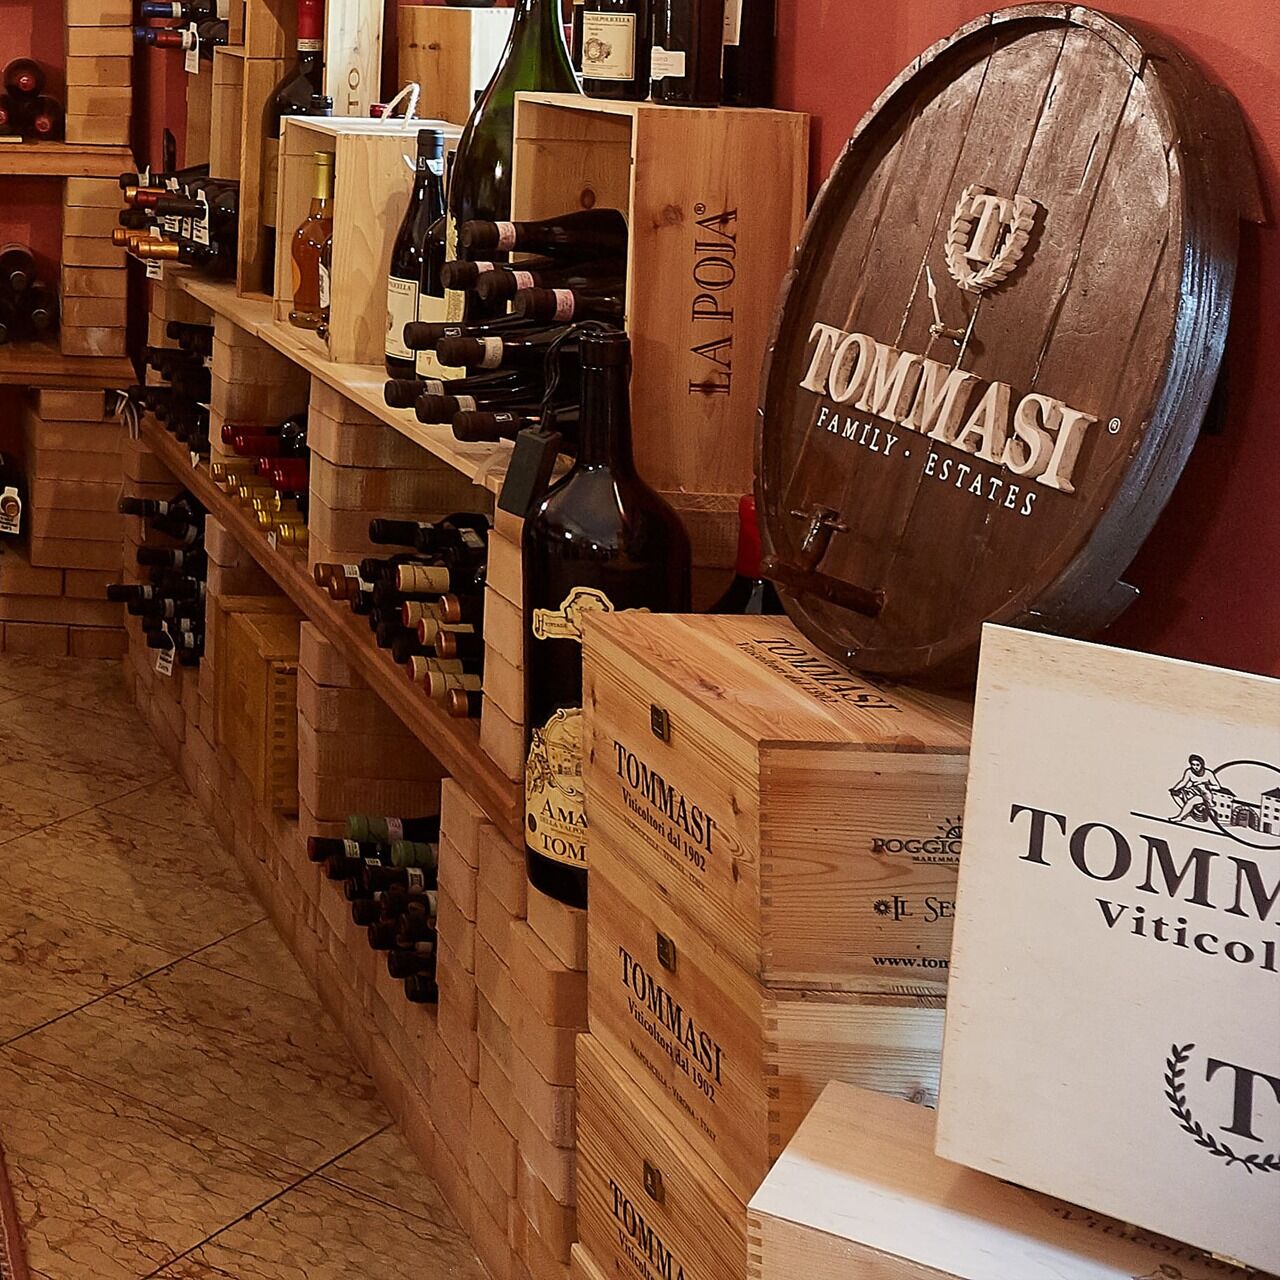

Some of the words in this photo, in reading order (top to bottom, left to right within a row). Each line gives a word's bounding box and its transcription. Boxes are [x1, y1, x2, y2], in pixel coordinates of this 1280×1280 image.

[692, 208, 738, 323] POJA
[688, 336, 733, 396] LA
[799, 322, 1099, 494] TOMMASI
[816, 407, 899, 458] FAMILY
[925, 452, 1037, 518] ESTATES
[753, 637, 904, 713] TOMMASI
[613, 740, 716, 855] TOMMASI
[621, 786, 666, 838] Viticoltori
[667, 828, 681, 850] dal
[683, 841, 707, 873] 1902
[618, 945, 723, 1087] TOMMASI
[627, 996, 674, 1062] Viticoltori
[674, 1047, 690, 1077] dal
[692, 1066, 716, 1103] 1902
